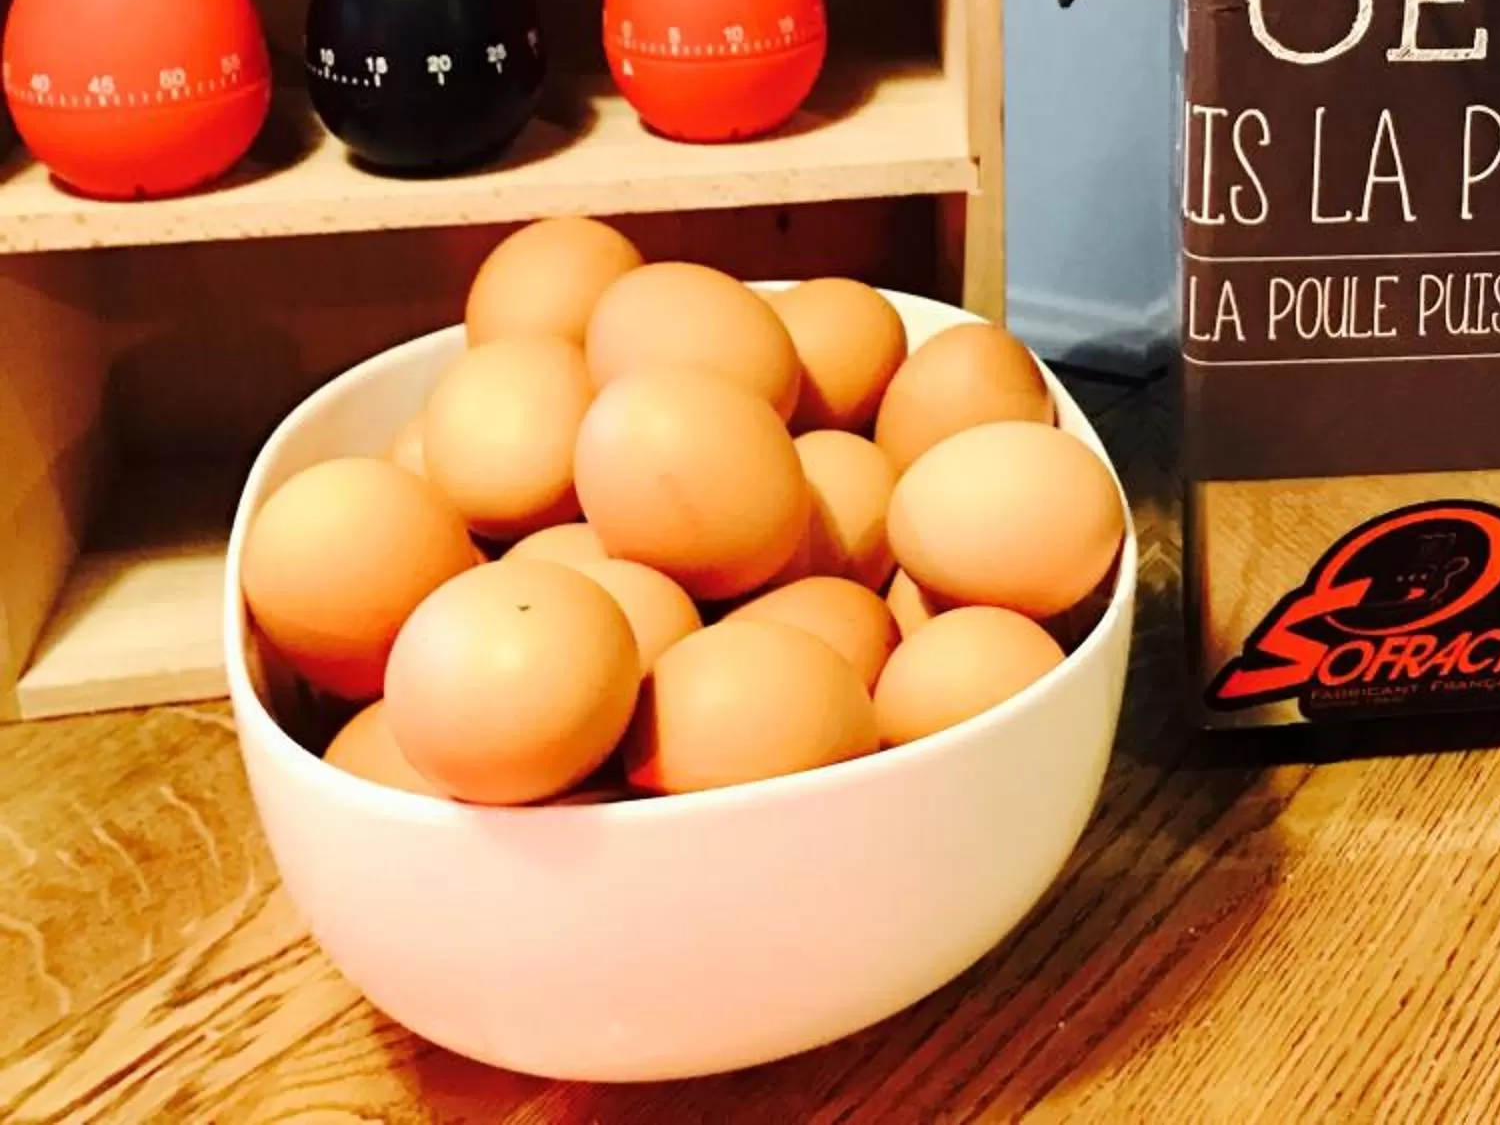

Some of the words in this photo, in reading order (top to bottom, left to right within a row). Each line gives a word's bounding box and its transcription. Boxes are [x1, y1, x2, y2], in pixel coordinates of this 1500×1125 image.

[426, 54, 453, 74] 20
[1310, 105, 1417, 225] LA
[1188, 275, 1246, 343] LA
[1266, 275, 1400, 341] POULE
